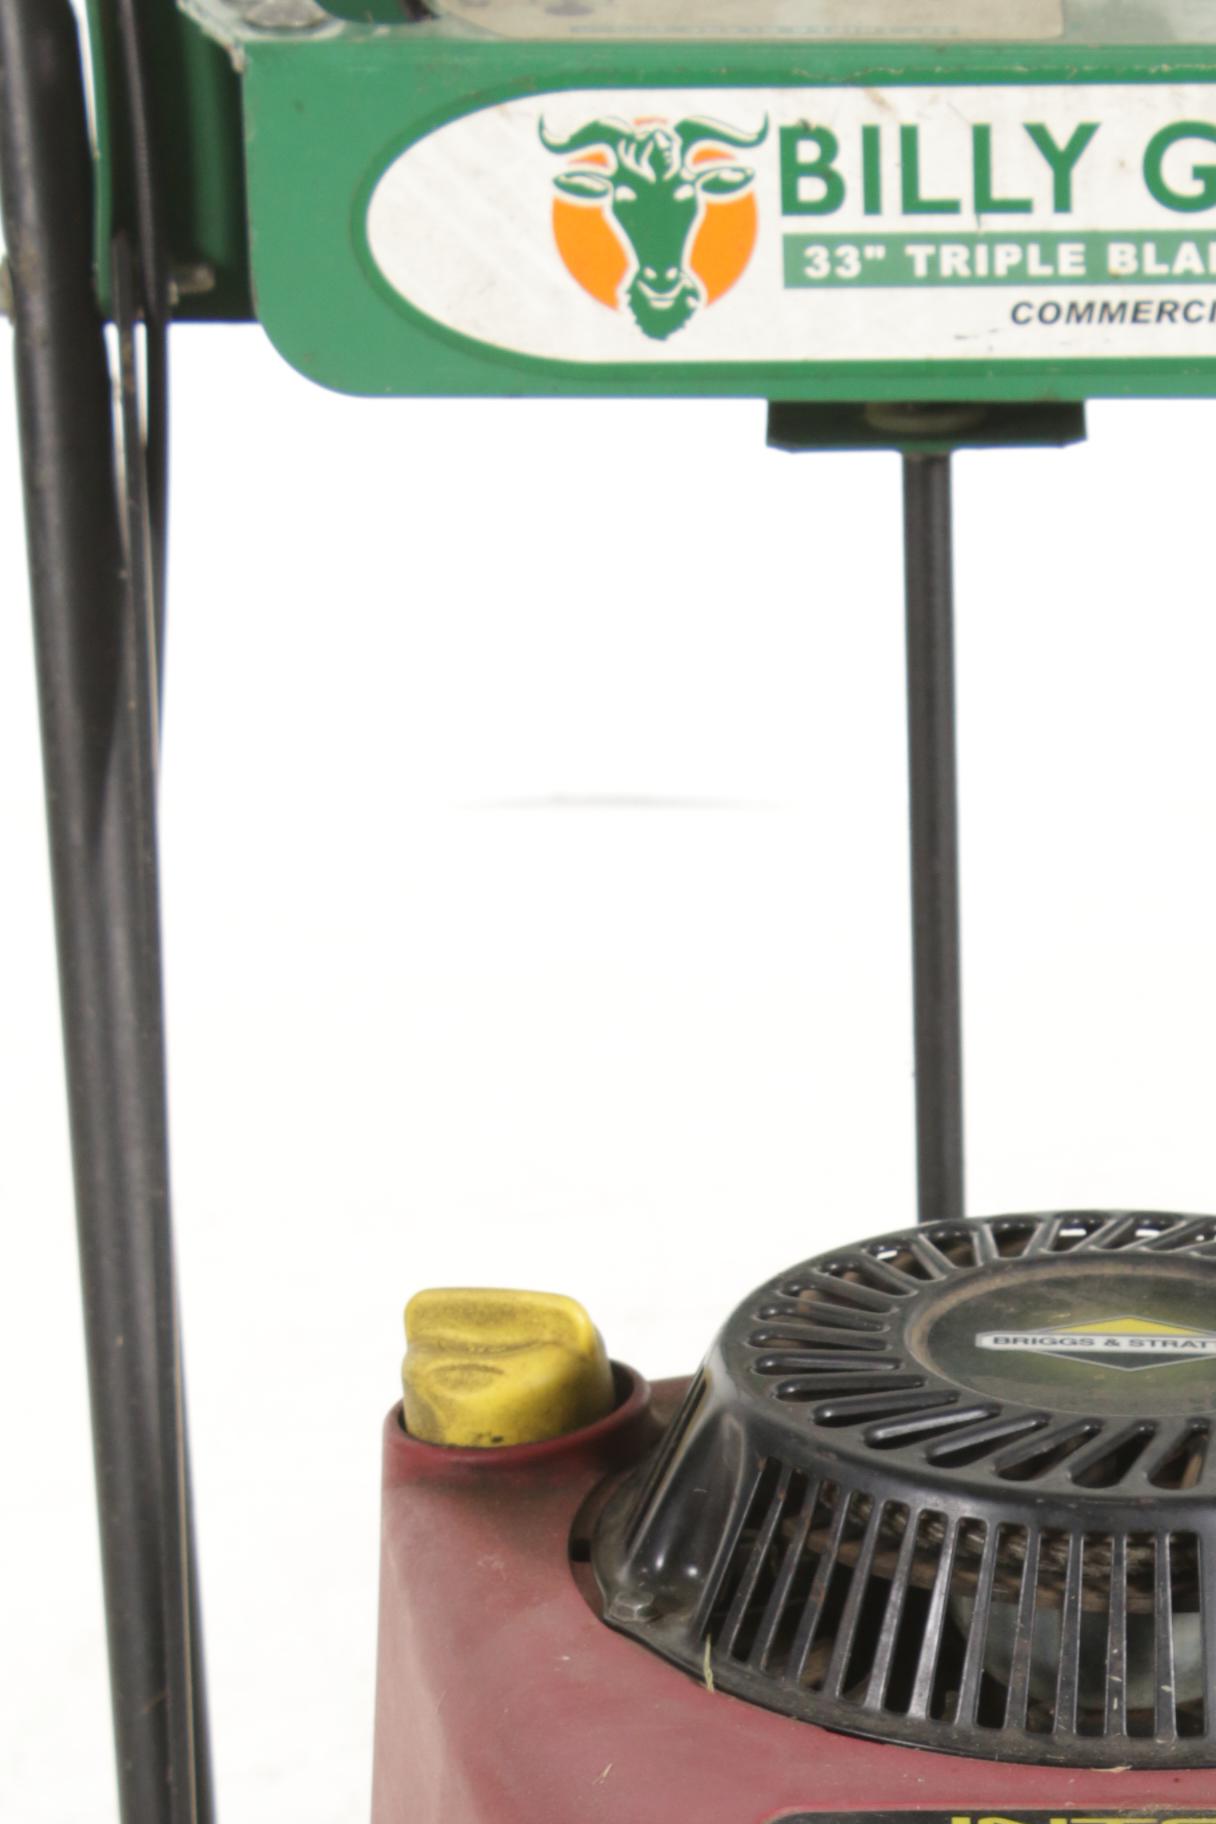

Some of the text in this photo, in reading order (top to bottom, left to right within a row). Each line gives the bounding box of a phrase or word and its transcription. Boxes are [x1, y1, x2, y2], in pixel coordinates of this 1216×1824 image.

[779, 121, 1101, 216] BILLY
[803, 244, 887, 280] 33"
[905, 241, 1086, 278] TRIPLE
[992, 1334, 1095, 1347] BRIGGS
[1103, 1336, 1121, 1348] &
